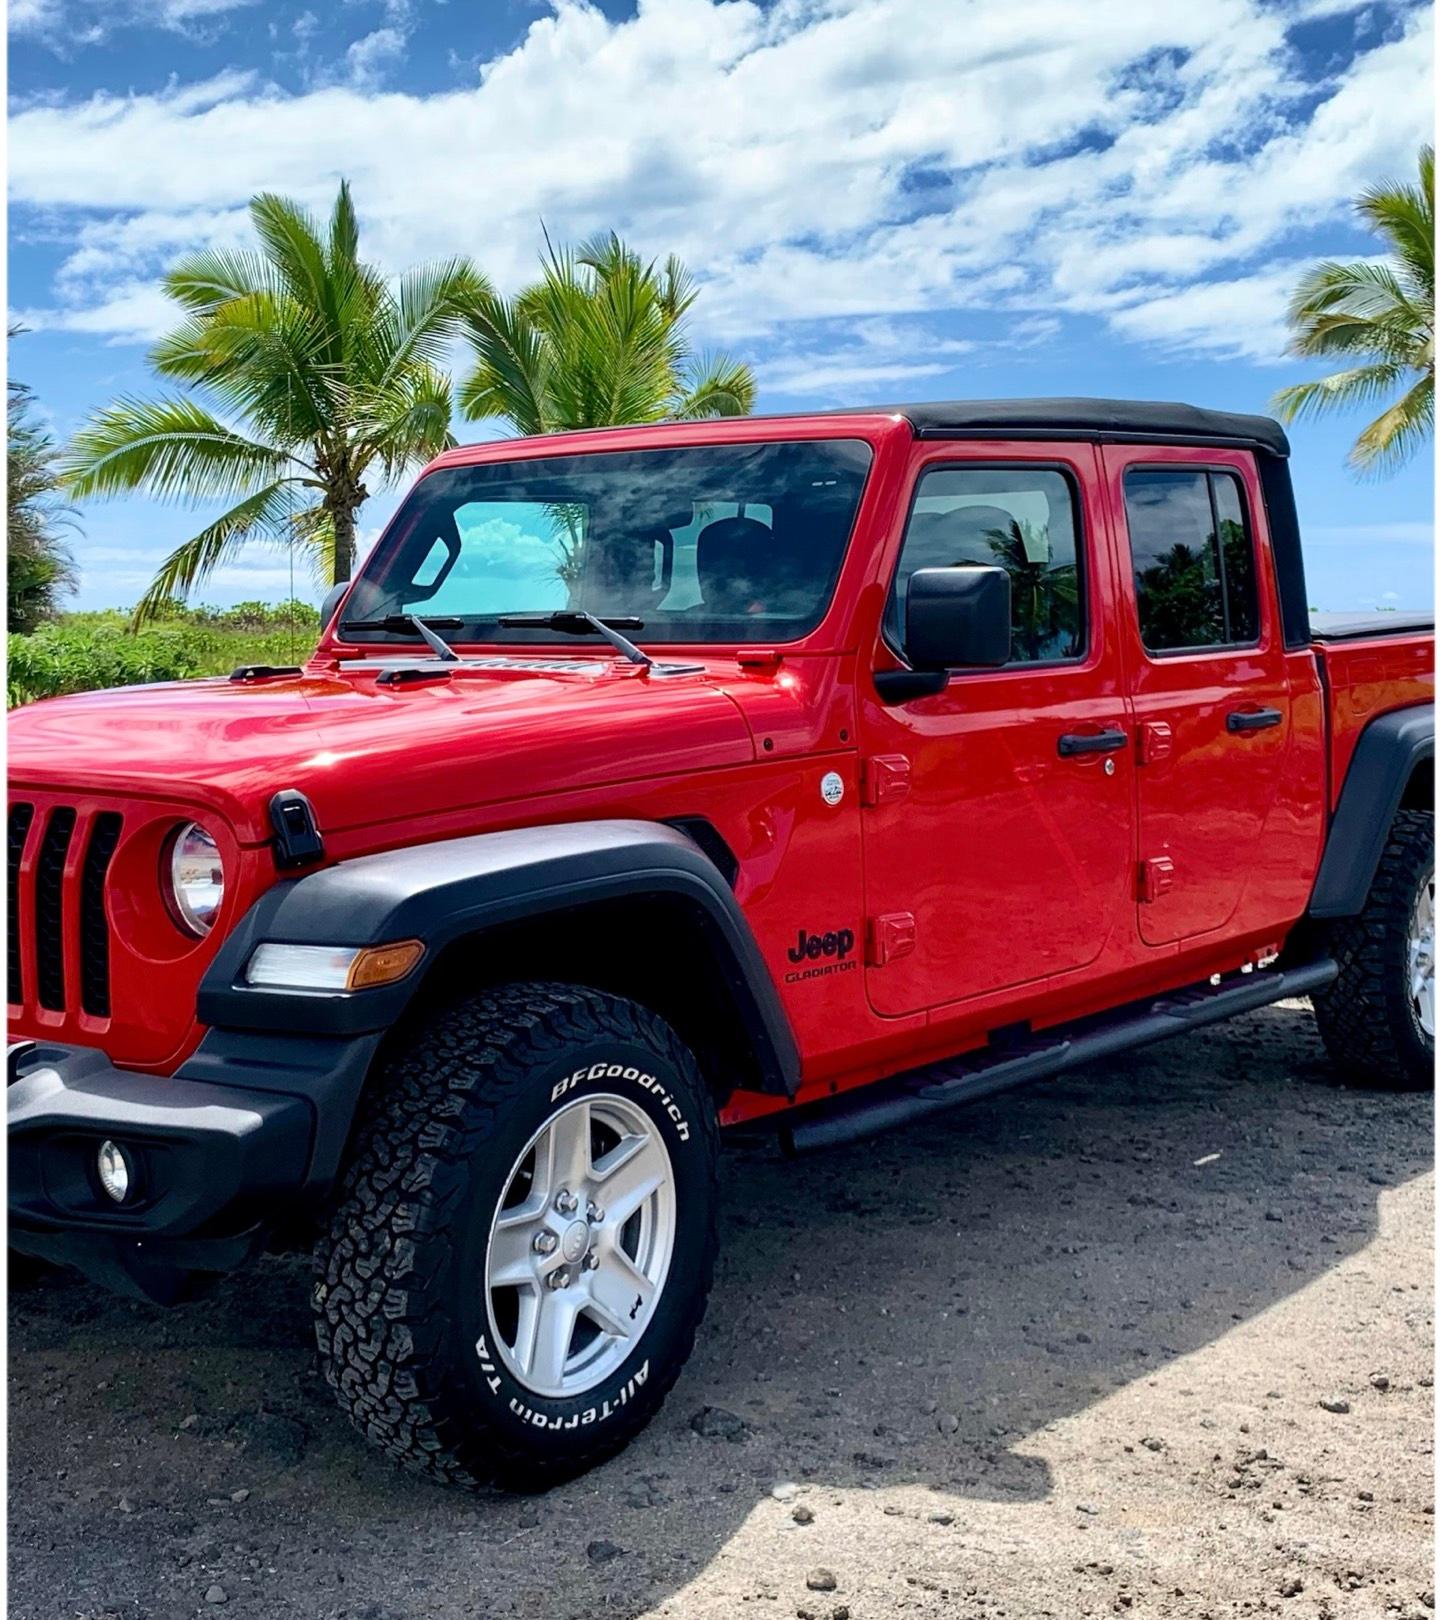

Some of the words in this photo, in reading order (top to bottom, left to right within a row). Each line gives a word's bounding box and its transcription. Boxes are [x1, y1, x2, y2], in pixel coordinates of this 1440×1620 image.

[785, 961, 857, 983] GLADIATOR
[787, 928, 854, 964] Jeep
[551, 1063, 690, 1141] BFGoodrich
[475, 1334, 502, 1395] T/A
[509, 1359, 649, 1430] All-Terrain
